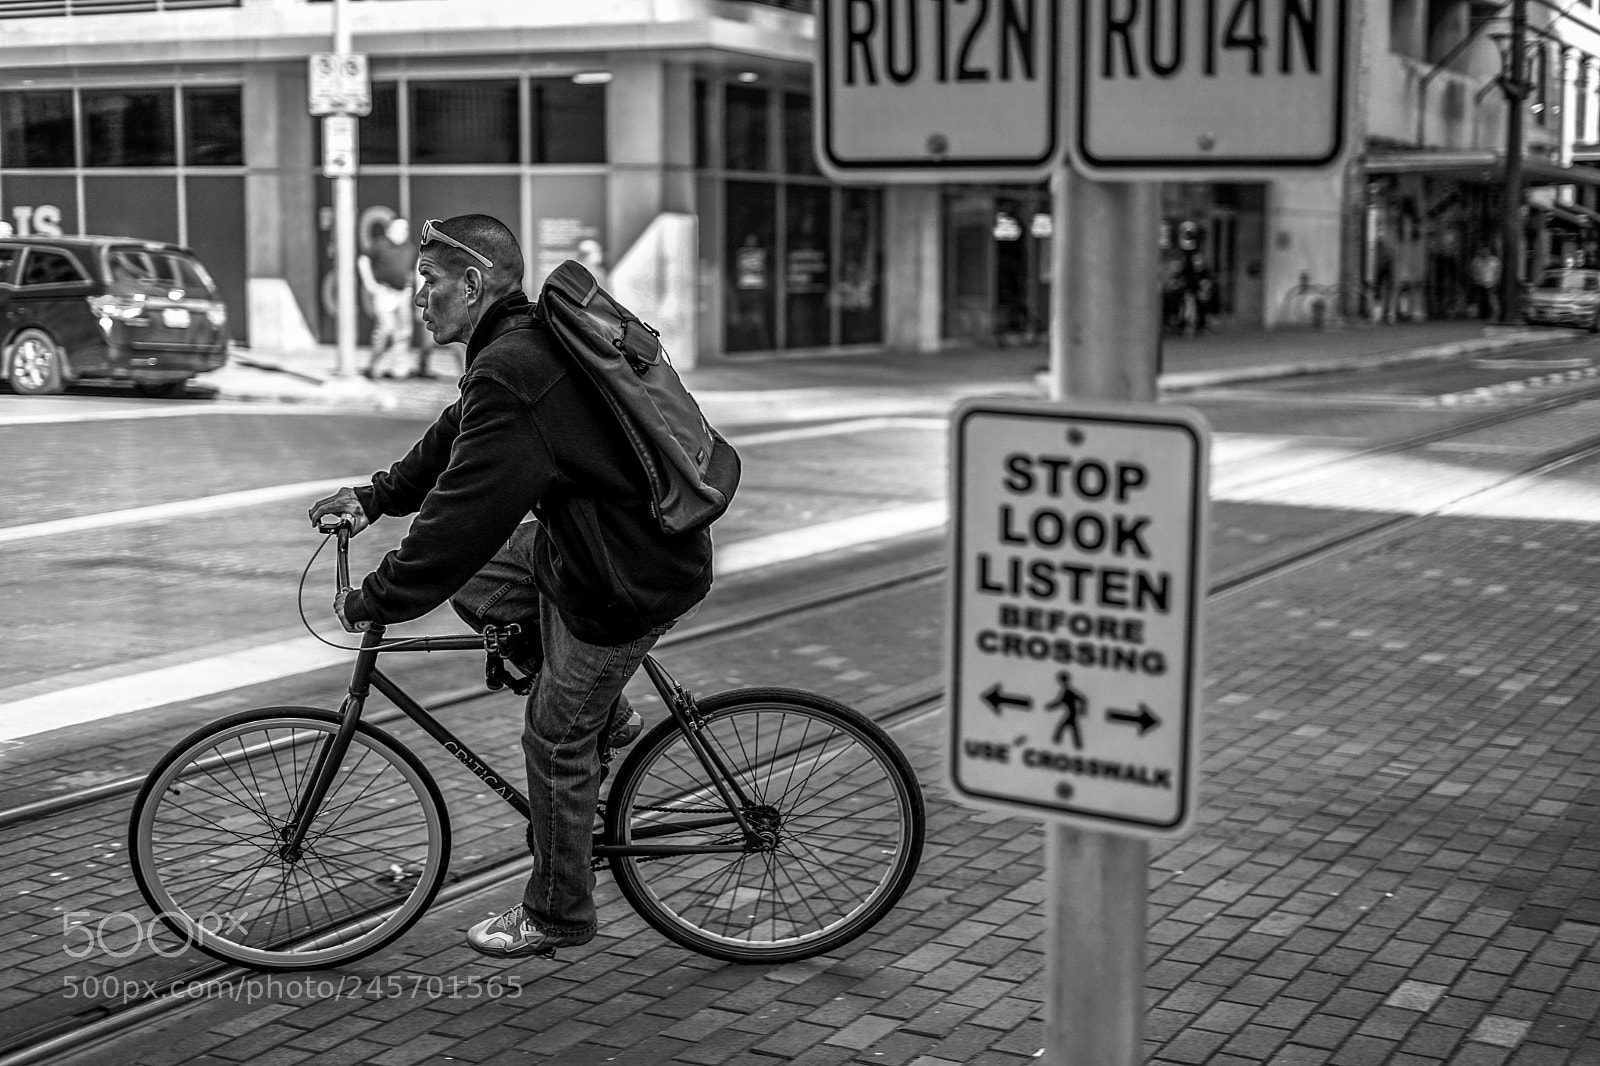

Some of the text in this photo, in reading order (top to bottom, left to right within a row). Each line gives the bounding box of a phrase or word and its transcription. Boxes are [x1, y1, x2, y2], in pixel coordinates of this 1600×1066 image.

[1002, 453, 1150, 504] STOP
[998, 503, 1152, 560] LOOK
[975, 552, 1172, 615] LISTEN
[998, 603, 1145, 645] BEFORE
[975, 630, 1168, 676] CROSSING
[964, 739, 1172, 789] USE CROSSWALK
